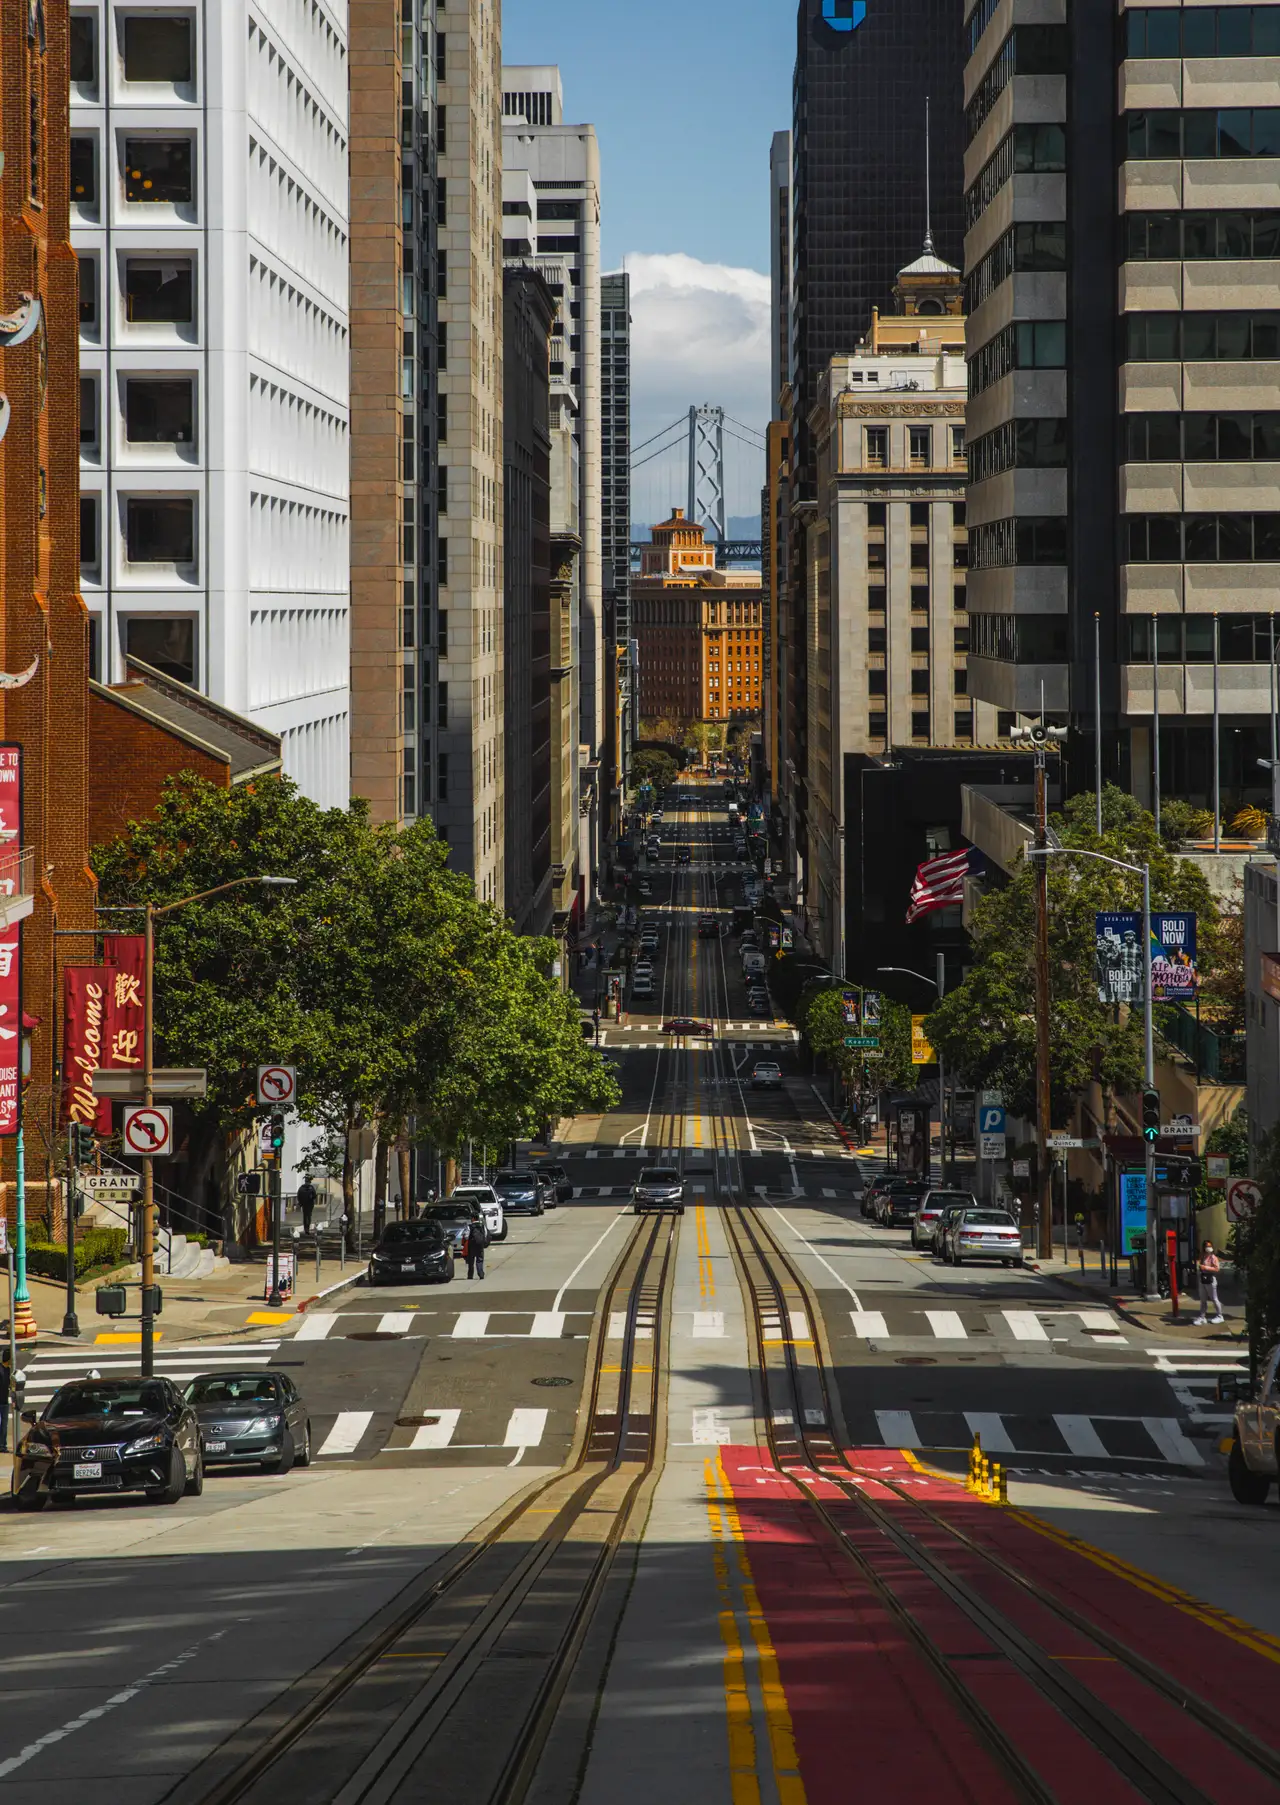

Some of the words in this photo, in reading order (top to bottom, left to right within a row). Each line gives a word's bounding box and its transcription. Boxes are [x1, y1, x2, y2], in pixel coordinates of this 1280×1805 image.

[1162, 920, 1185, 931] BOLD
[1162, 932, 1185, 944] NOW
[1108, 970, 1132, 981] BOLD
[1108, 981, 1132, 992] THEN
[1164, 1126, 1194, 1134] GRANT
[89, 1177, 137, 1187] GRANT
